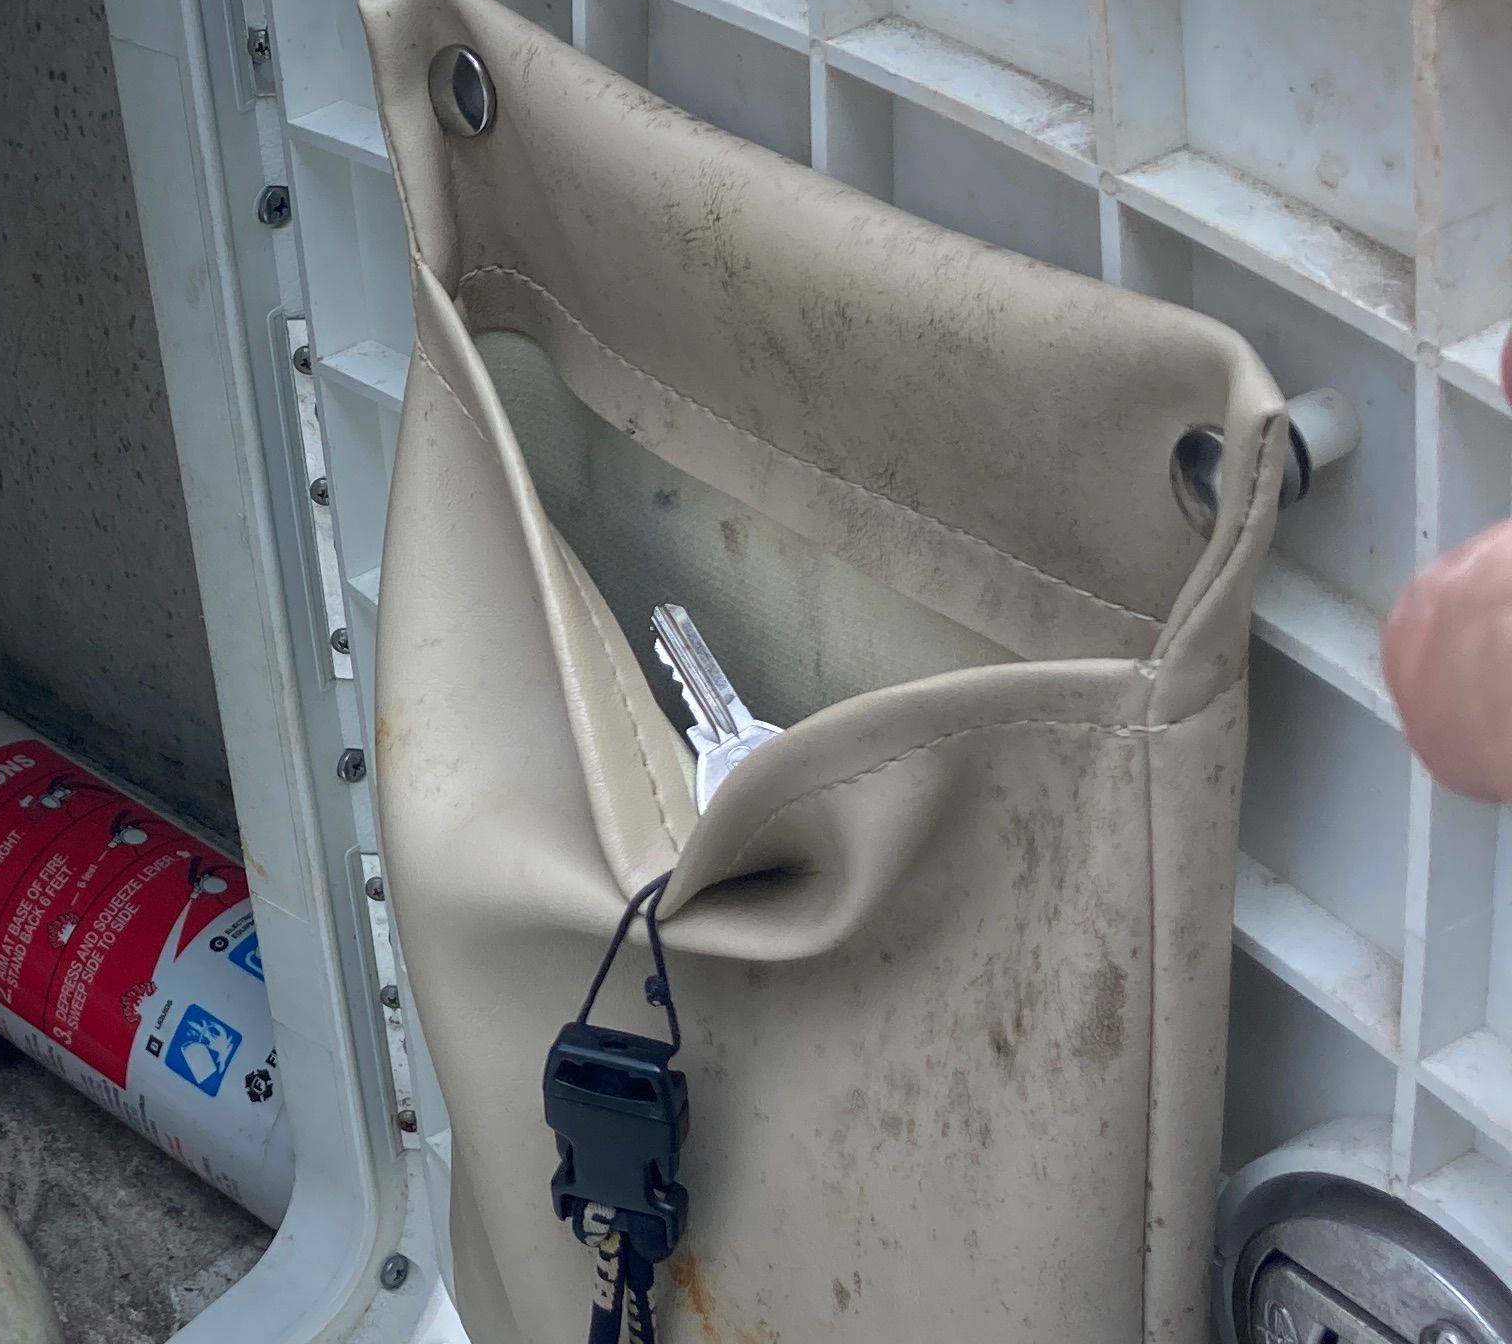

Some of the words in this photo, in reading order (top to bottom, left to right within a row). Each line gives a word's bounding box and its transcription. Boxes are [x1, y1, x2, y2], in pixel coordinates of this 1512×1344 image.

[39, 852, 70, 881] FIRE.
[44, 864, 78, 898] FEET.
[27, 879, 44, 900] OF
[77, 879, 87, 889] 6
[7, 898, 34, 937] BASE
[39, 894, 52, 908] 6
[92, 876, 143, 932] SQUEEZE
[19, 906, 46, 945] BACK
[1, 933, 16, 958] AT
[76, 930, 99, 963] AND
[7, 942, 27, 989] STAND
[67, 982, 88, 1030] SWEEP
[80, 949, 105, 985] SIDE
[98, 931, 116, 951] TO
[55, 959, 83, 1024] DEPRESS
[53, 1025, 73, 1046] 3.
